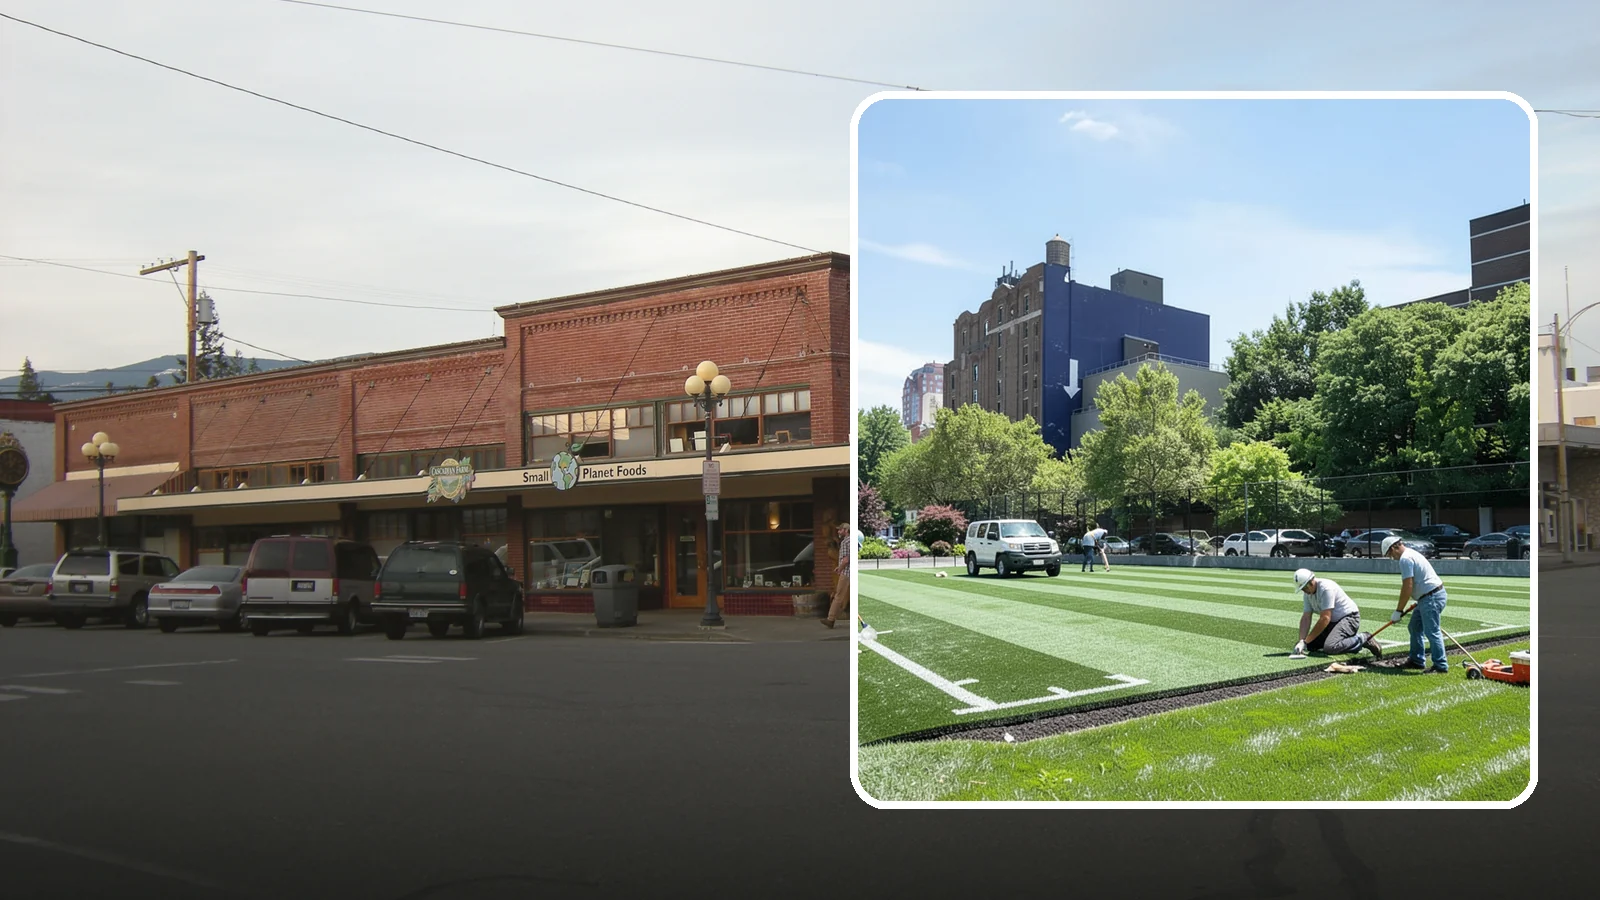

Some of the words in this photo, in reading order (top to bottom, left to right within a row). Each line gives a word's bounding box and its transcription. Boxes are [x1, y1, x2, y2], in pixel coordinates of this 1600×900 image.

[523, 471, 549, 483] Small
[583, 468, 614, 479] Planet
[617, 464, 647, 477] Foods
